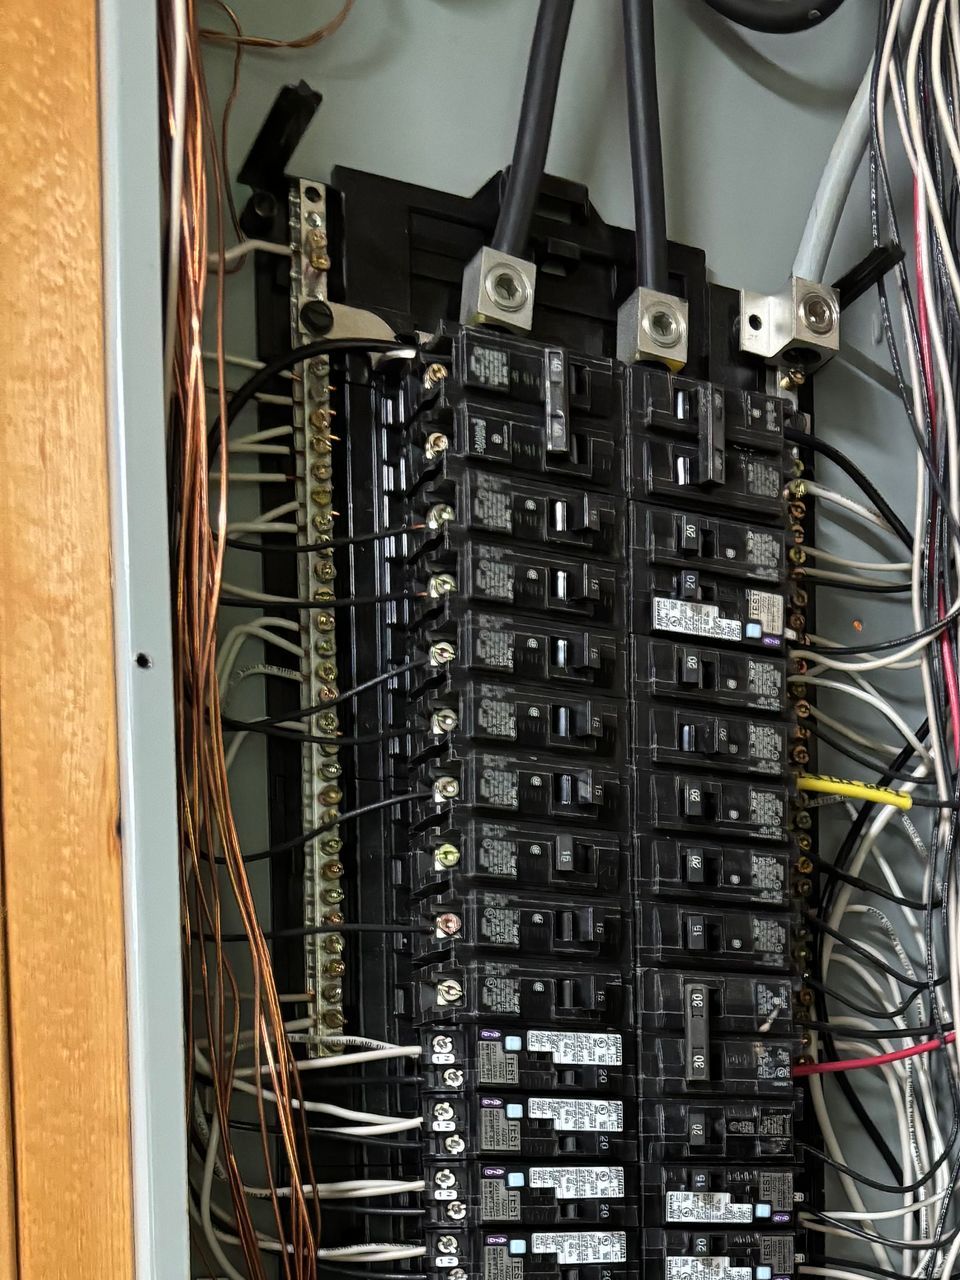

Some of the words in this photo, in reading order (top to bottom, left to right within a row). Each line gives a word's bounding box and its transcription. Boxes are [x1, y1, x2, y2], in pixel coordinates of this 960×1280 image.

[686, 525, 695, 537] 20
[686, 575, 695, 588] 20
[752, 592, 760, 616] TEST
[687, 656, 697, 668] 20
[690, 789, 700, 801] 20
[691, 856, 701, 868] 20
[692, 925, 702, 936] 15
[692, 994, 703, 1006] 30
[693, 1056, 705, 1068] 30
[599, 1069, 607, 1083] 20
[692, 1124, 703, 1135] 20
[600, 1136, 608, 1149] 20
[695, 1175, 705, 1187] 15
[600, 1204, 609, 1218] 20
[697, 1239, 707, 1252] 20
